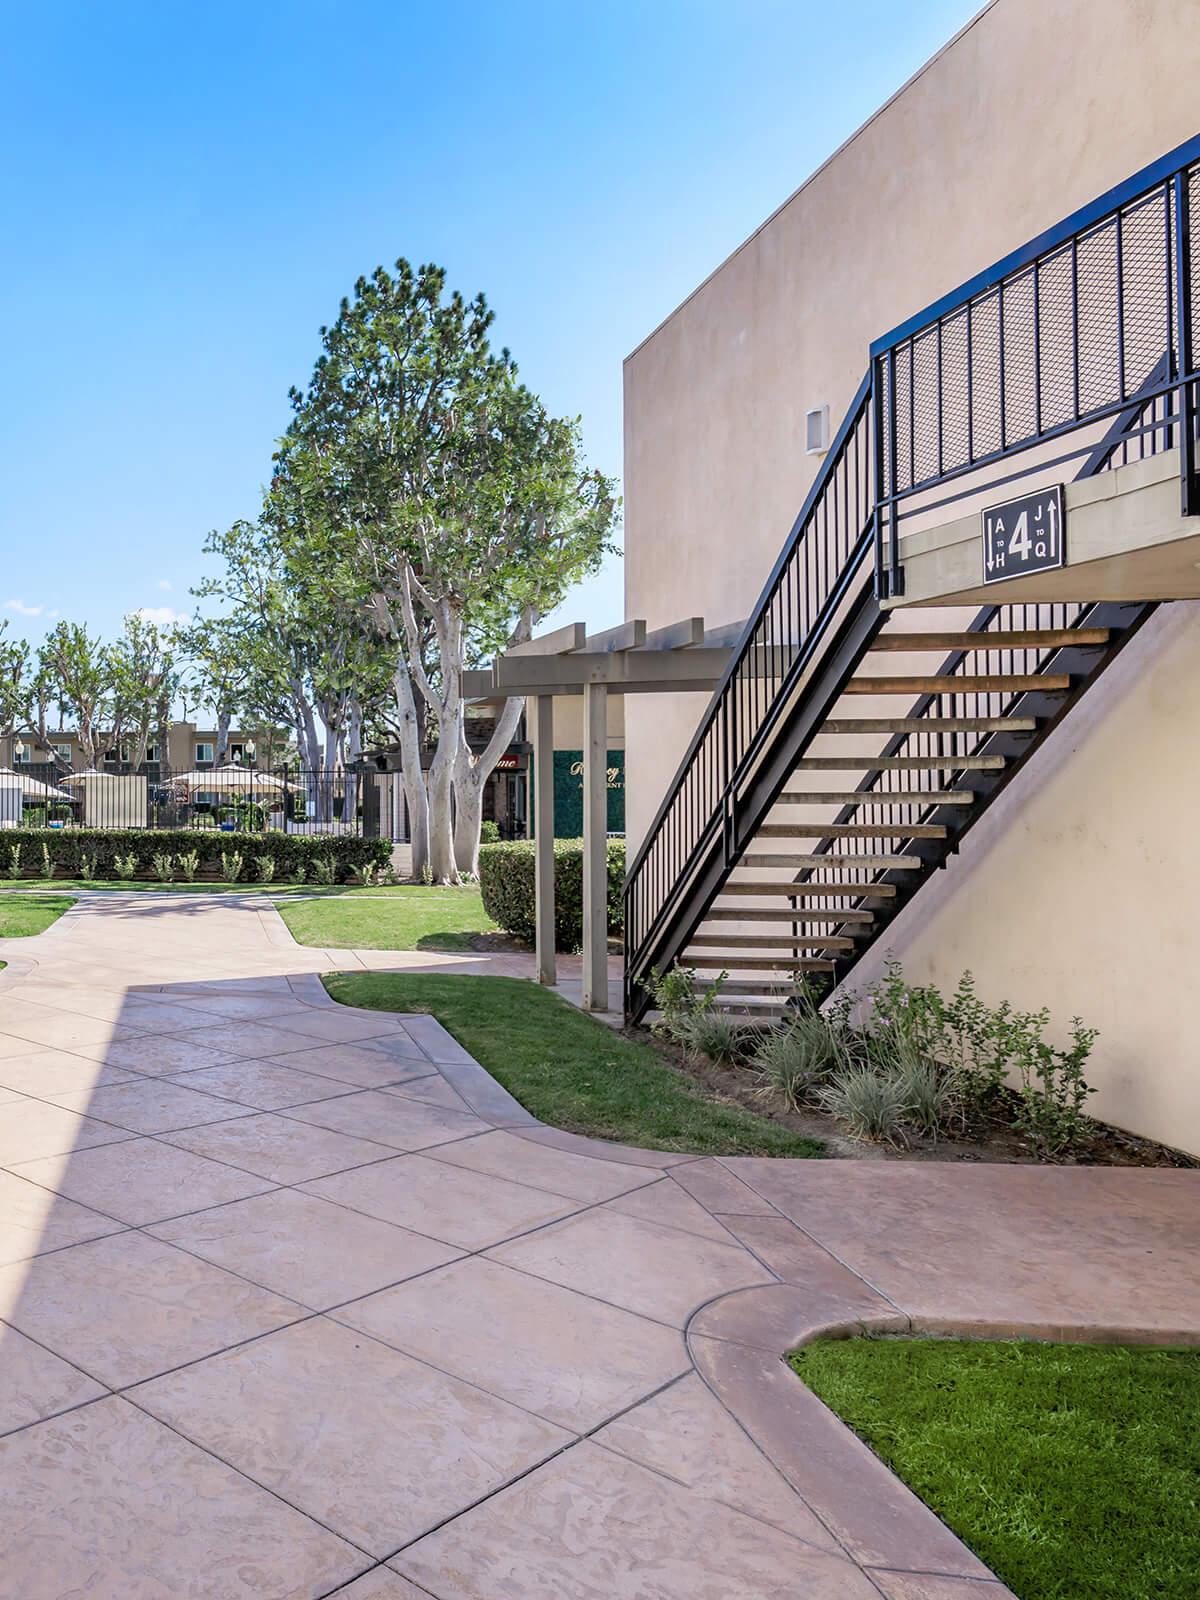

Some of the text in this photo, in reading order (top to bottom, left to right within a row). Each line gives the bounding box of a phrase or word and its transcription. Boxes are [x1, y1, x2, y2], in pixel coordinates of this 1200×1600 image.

[1034, 505, 1042, 521] J
[995, 518, 1005, 533] A
[1008, 511, 1032, 560] 4
[1035, 541, 1046, 557] Q
[996, 552, 1005, 568] H
